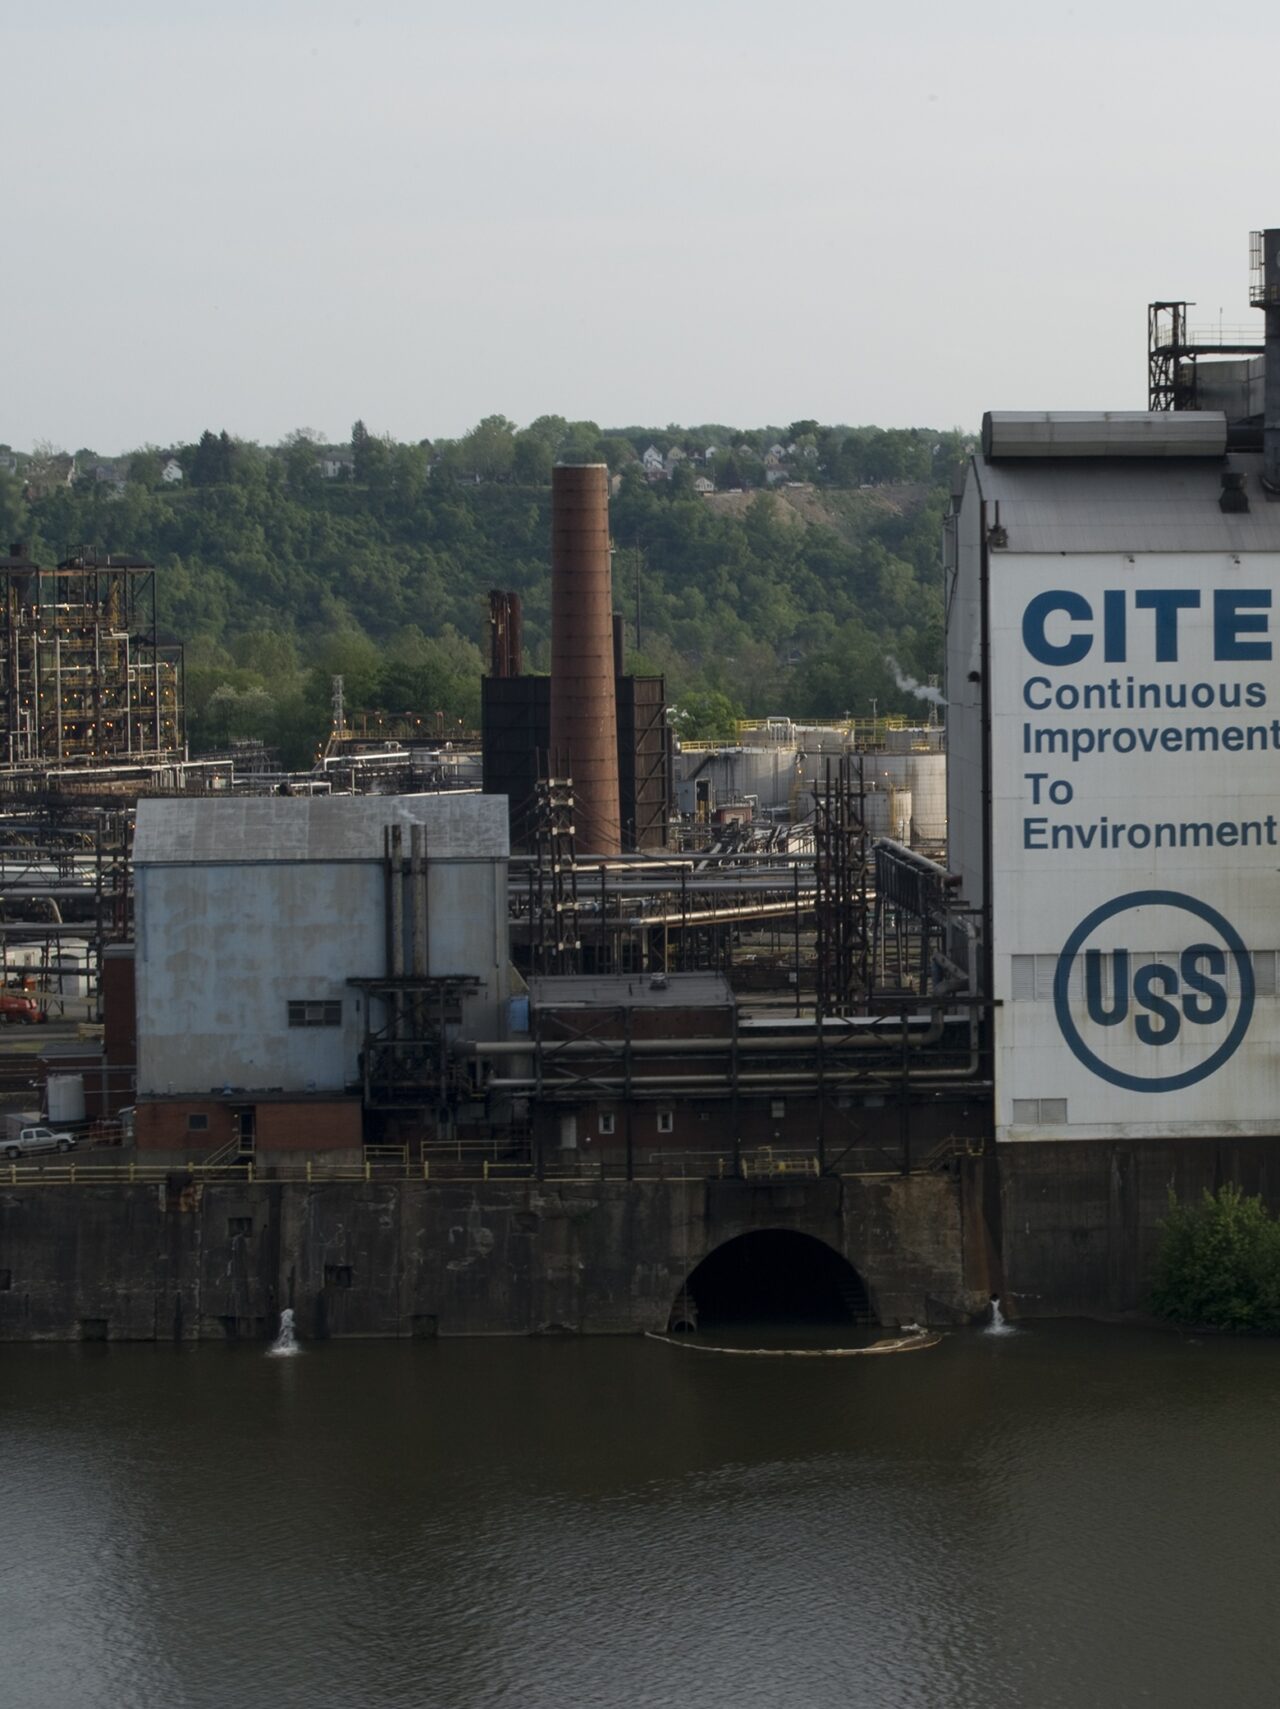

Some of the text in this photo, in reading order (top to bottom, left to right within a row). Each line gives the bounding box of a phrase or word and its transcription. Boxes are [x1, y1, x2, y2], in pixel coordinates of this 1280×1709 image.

[1022, 588, 1273, 667] CITE
[1023, 676, 1267, 711] Continuous
[1025, 773, 1074, 805] To
[1023, 815, 1278, 850] Environment
[1084, 943, 1228, 1046] USS
